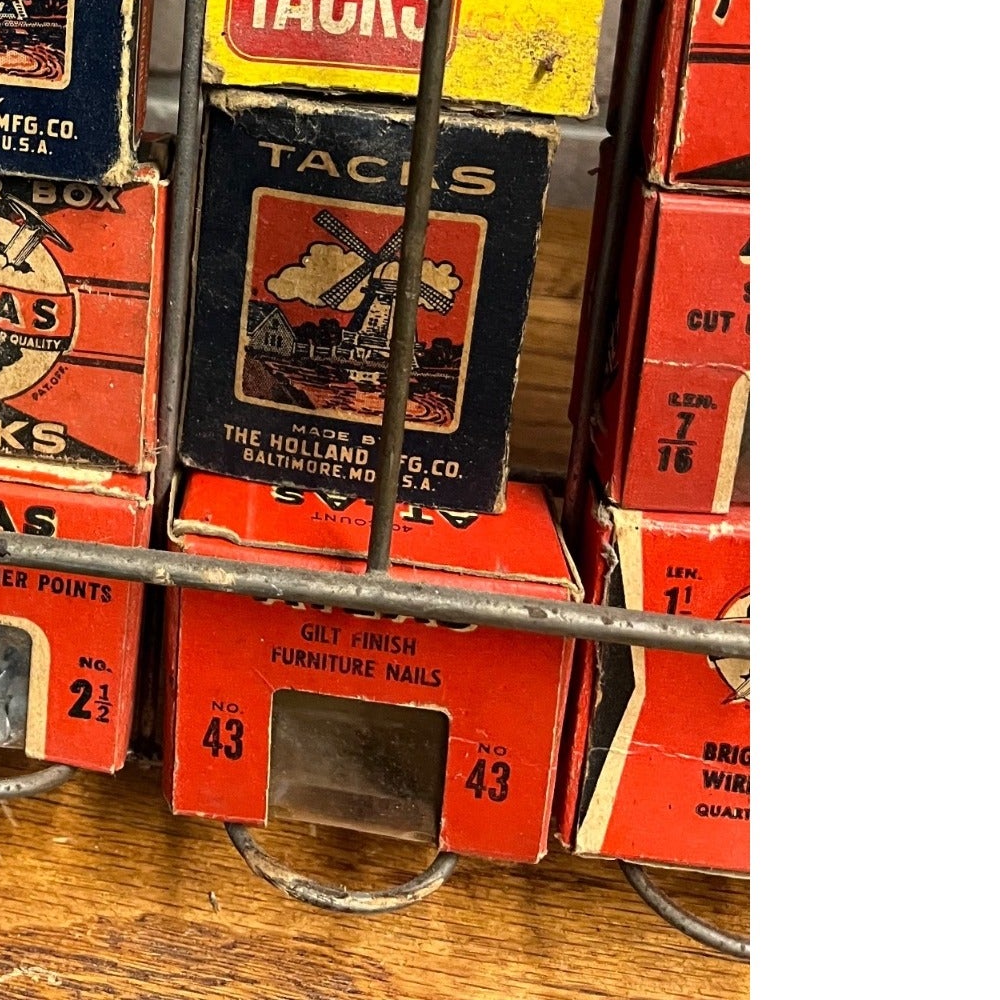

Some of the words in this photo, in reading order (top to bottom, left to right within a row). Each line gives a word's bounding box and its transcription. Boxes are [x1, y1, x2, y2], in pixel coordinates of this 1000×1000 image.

[32, 181, 125, 213] BOX
[687, 308, 735, 333] CUT
[10, 333, 62, 350] QUALITY
[668, 392, 718, 410] LEN.
[224, 424, 261, 447] THE
[269, 434, 369, 466] HOLLAND
[293, 424, 350, 441] MADE
[361, 435, 381, 446] B
[666, 565, 703, 581] LEN.
[38, 575, 112, 603] POINTS
[301, 622, 340, 645] GILT
[351, 631, 417, 656] FINISH
[78, 656, 113, 674] NO.
[271, 646, 376, 679] FURNITURE
[386, 661, 442, 688] NAILS
[211, 700, 244, 715] NO.
[202, 716, 244, 762] 43
[465, 757, 511, 803] 43
